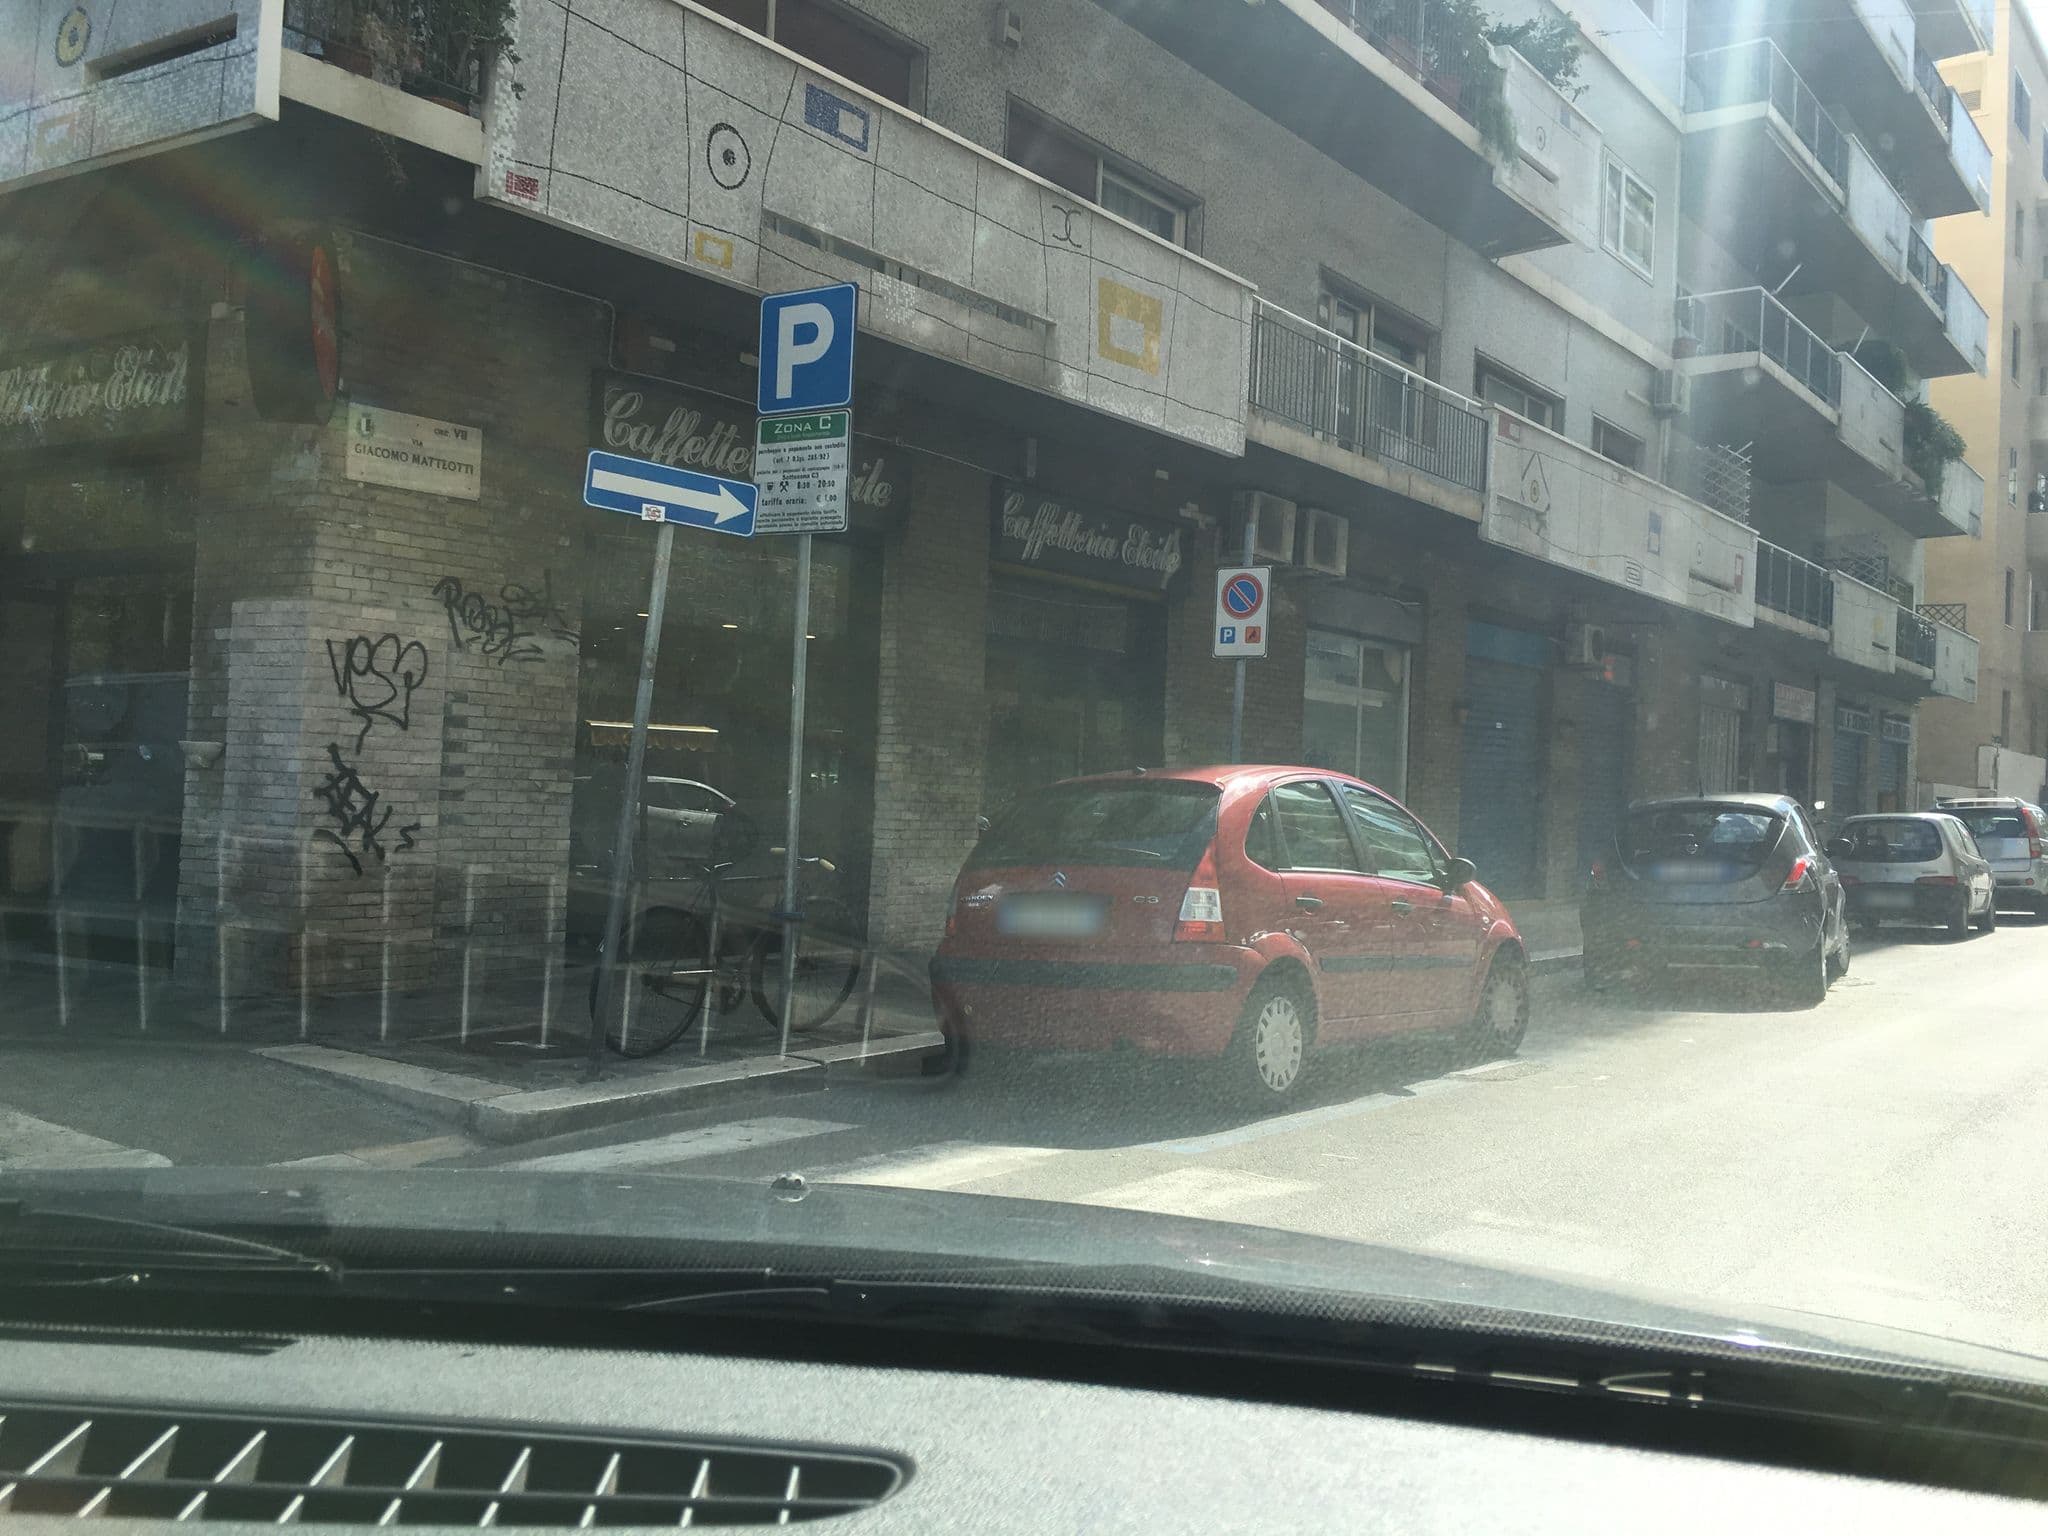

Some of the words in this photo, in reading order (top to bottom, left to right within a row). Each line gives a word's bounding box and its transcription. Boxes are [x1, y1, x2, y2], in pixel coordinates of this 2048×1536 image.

[776, 302, 835, 400] P
[774, 422, 813, 434] ZONA
[819, 415, 832, 430] C
[453, 428, 468, 441] VII
[412, 438, 424, 448] VIA
[354, 443, 409, 463] GIACOMO
[412, 453, 474, 475] MATTEOTTI
[1002, 489, 1119, 560] Caffetteria
[1223, 628, 1233, 642] P
[1133, 894, 1160, 904] C3
